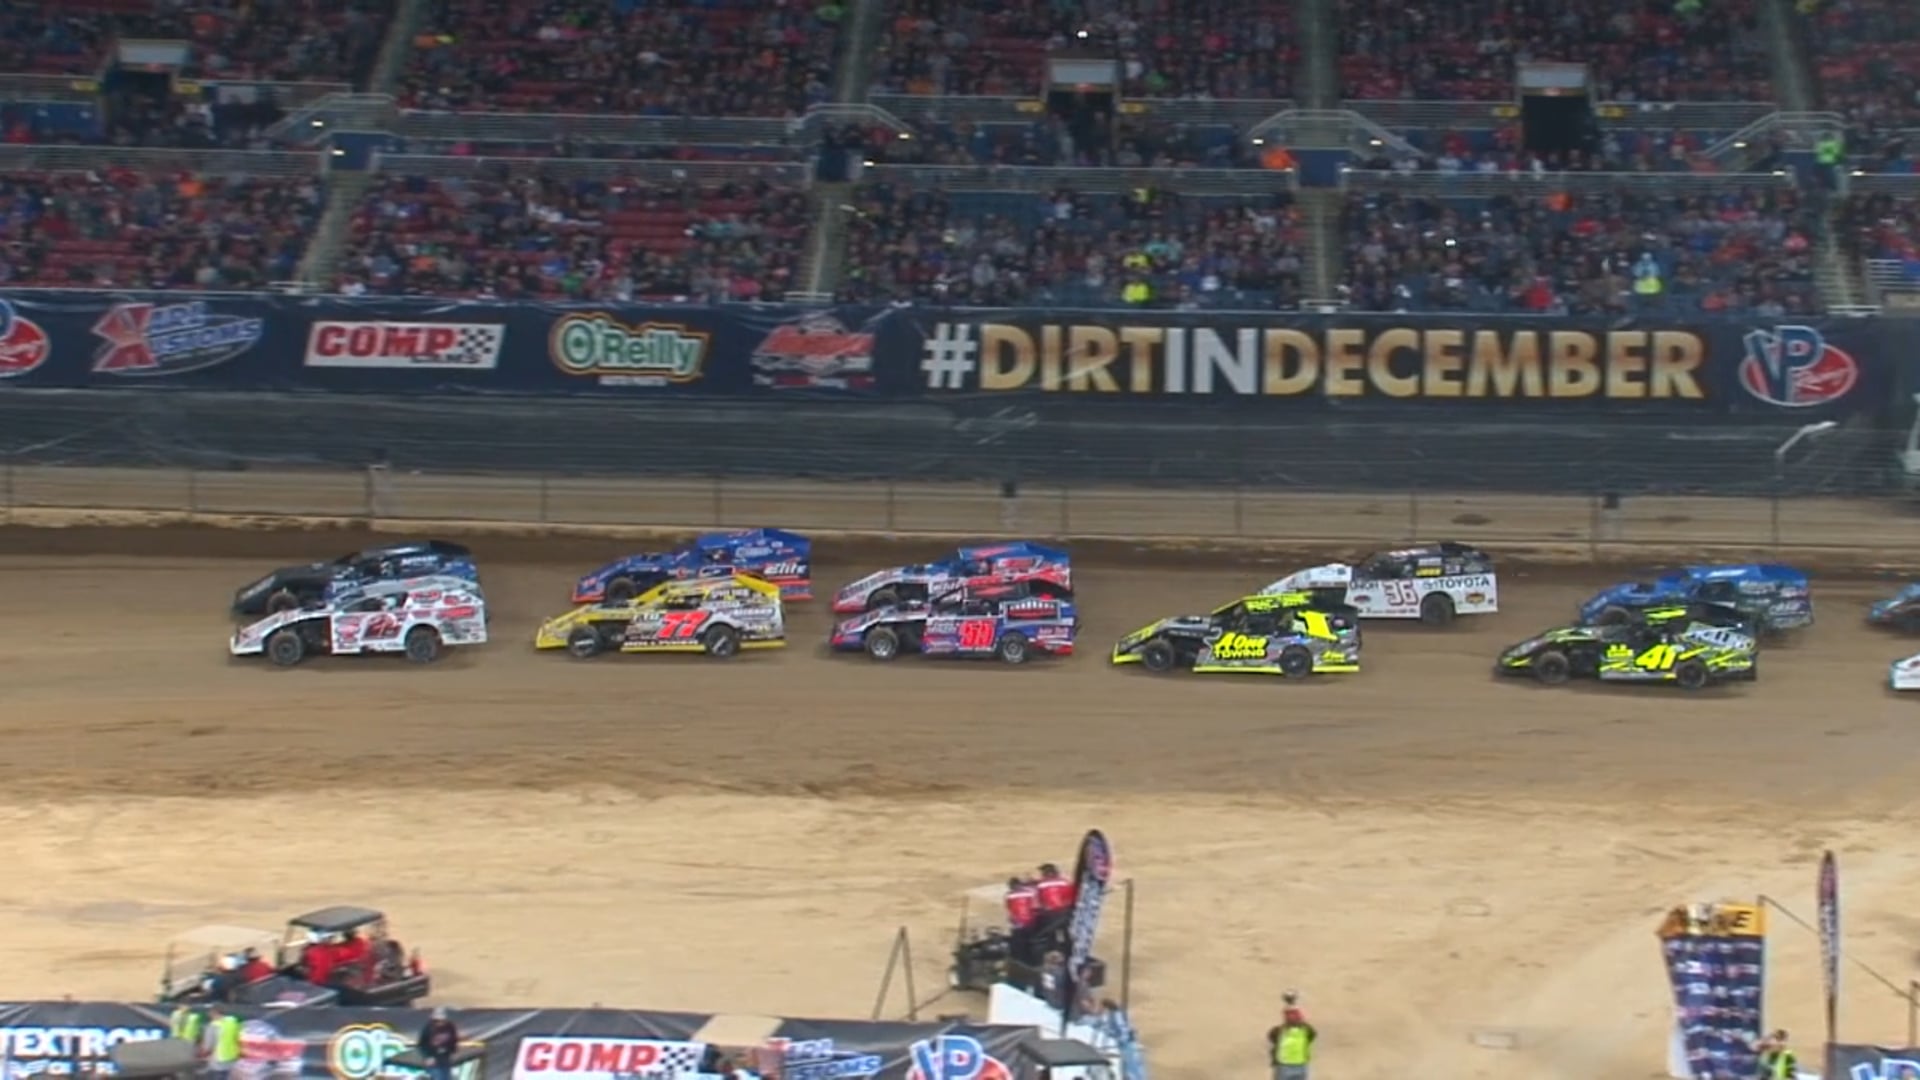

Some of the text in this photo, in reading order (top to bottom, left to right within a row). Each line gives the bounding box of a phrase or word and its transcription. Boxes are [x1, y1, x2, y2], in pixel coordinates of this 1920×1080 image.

[315, 326, 457, 358] COMP
[563, 320, 701, 374] O'Reilly
[1743, 325, 1824, 402] VP
[1383, 580, 1419, 606] 36
[1439, 576, 1491, 589] TOYOTA
[656, 609, 711, 639] 77
[1212, 647, 1267, 660] TOWING
[1635, 644, 1677, 670] 41
[524, 1042, 658, 1073] COMP
